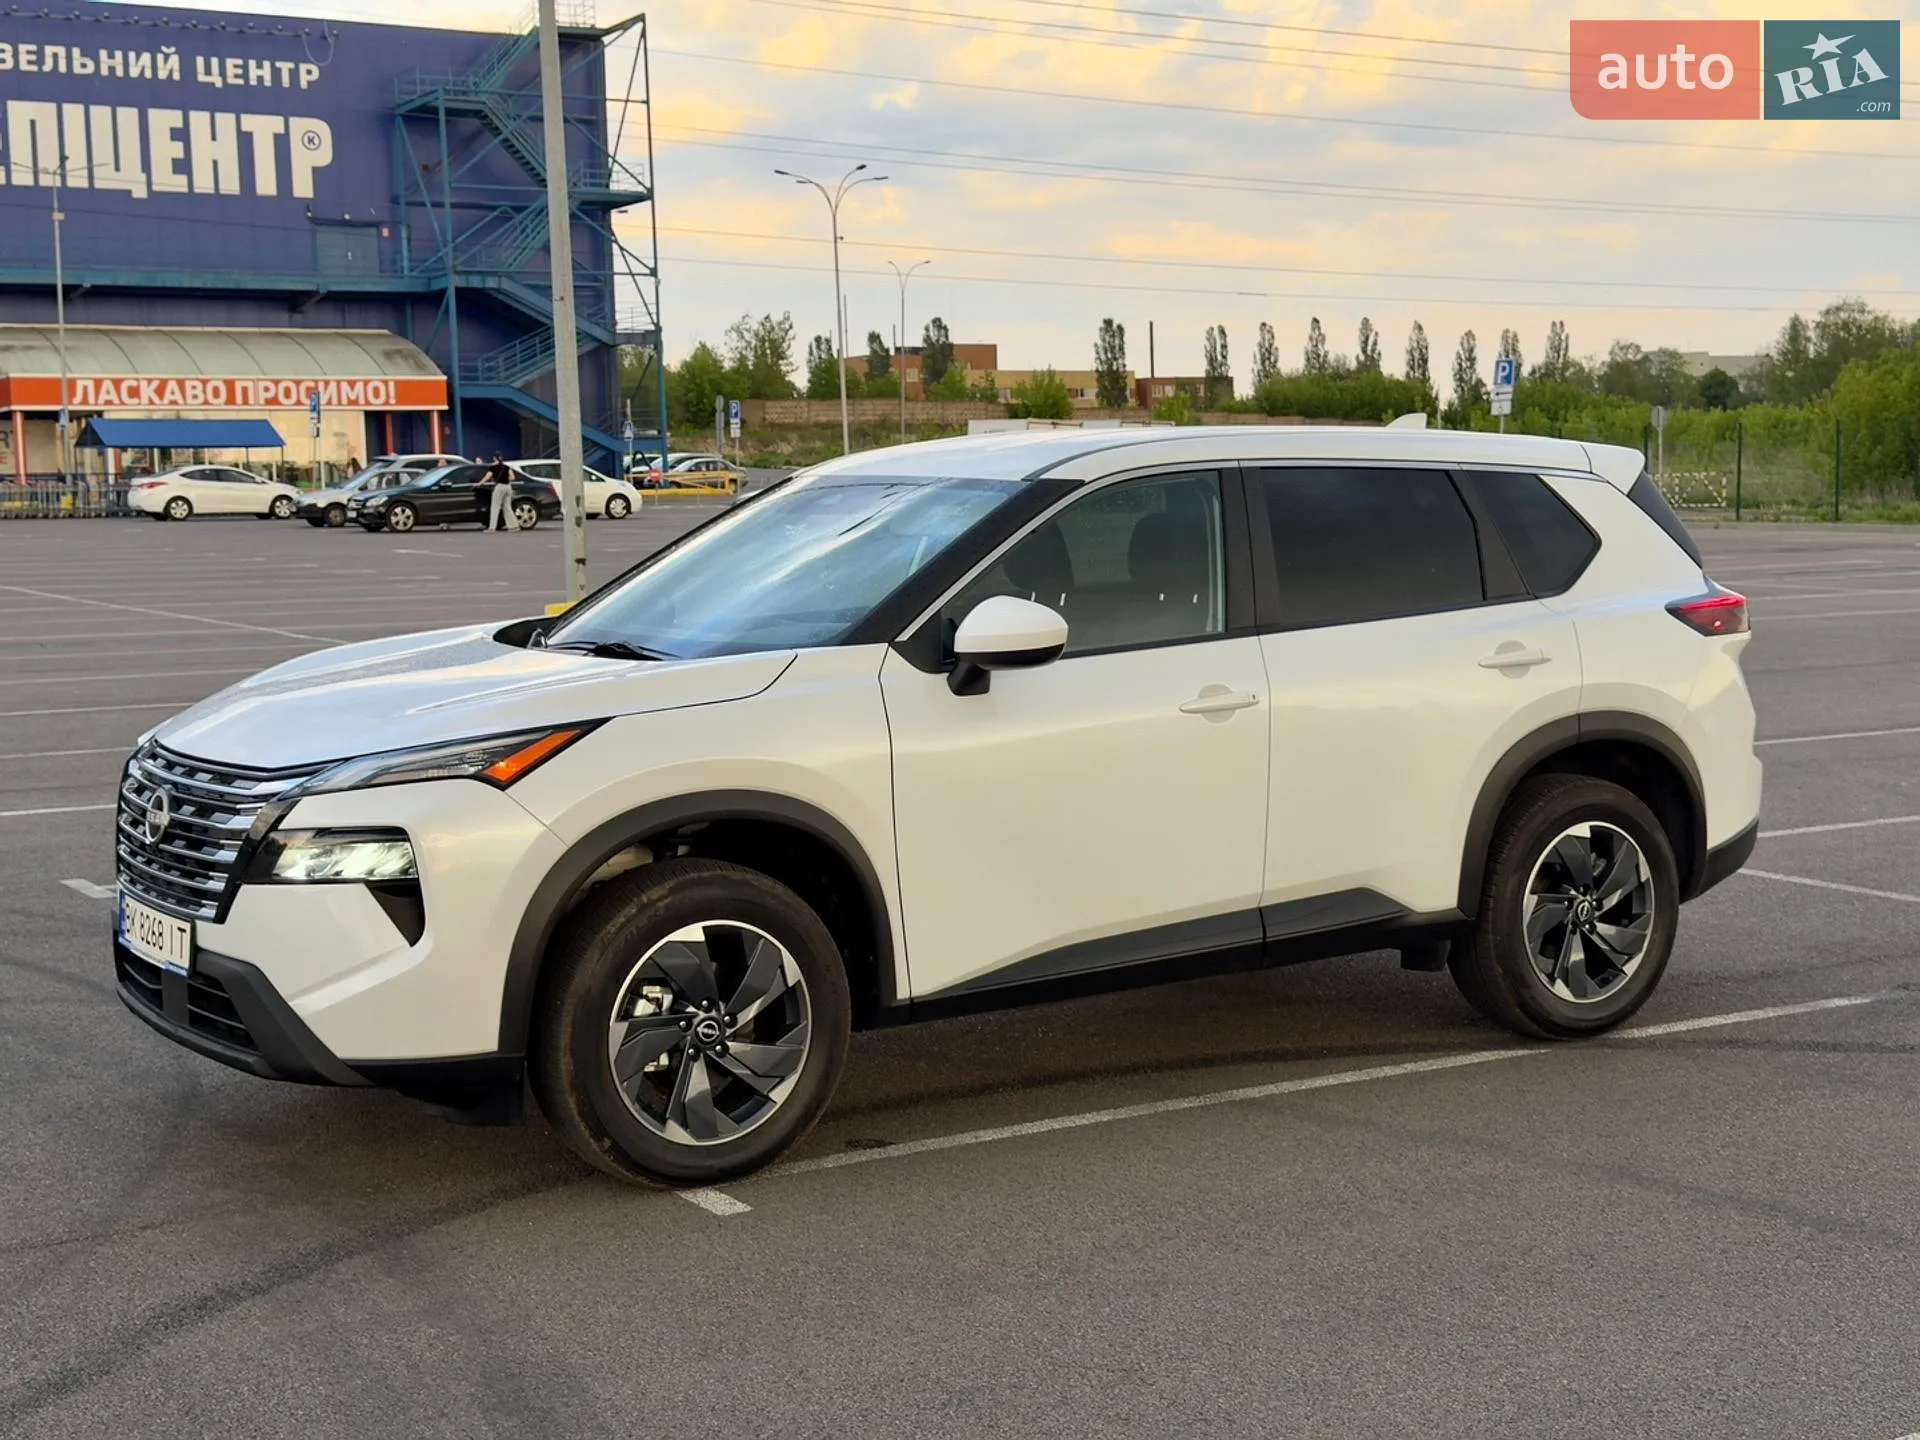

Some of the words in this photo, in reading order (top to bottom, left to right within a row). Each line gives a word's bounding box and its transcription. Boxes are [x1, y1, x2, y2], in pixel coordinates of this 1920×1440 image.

[196, 55, 320, 90] ЦЕНТР
[0, 99, 333, 199] ПІЦЕНТР
[1498, 361, 1510, 384] P
[72, 378, 228, 406] ЛАСКАВО
[234, 379, 397, 405] ПРОСИМО!
[140, 911, 164, 951] 8268
